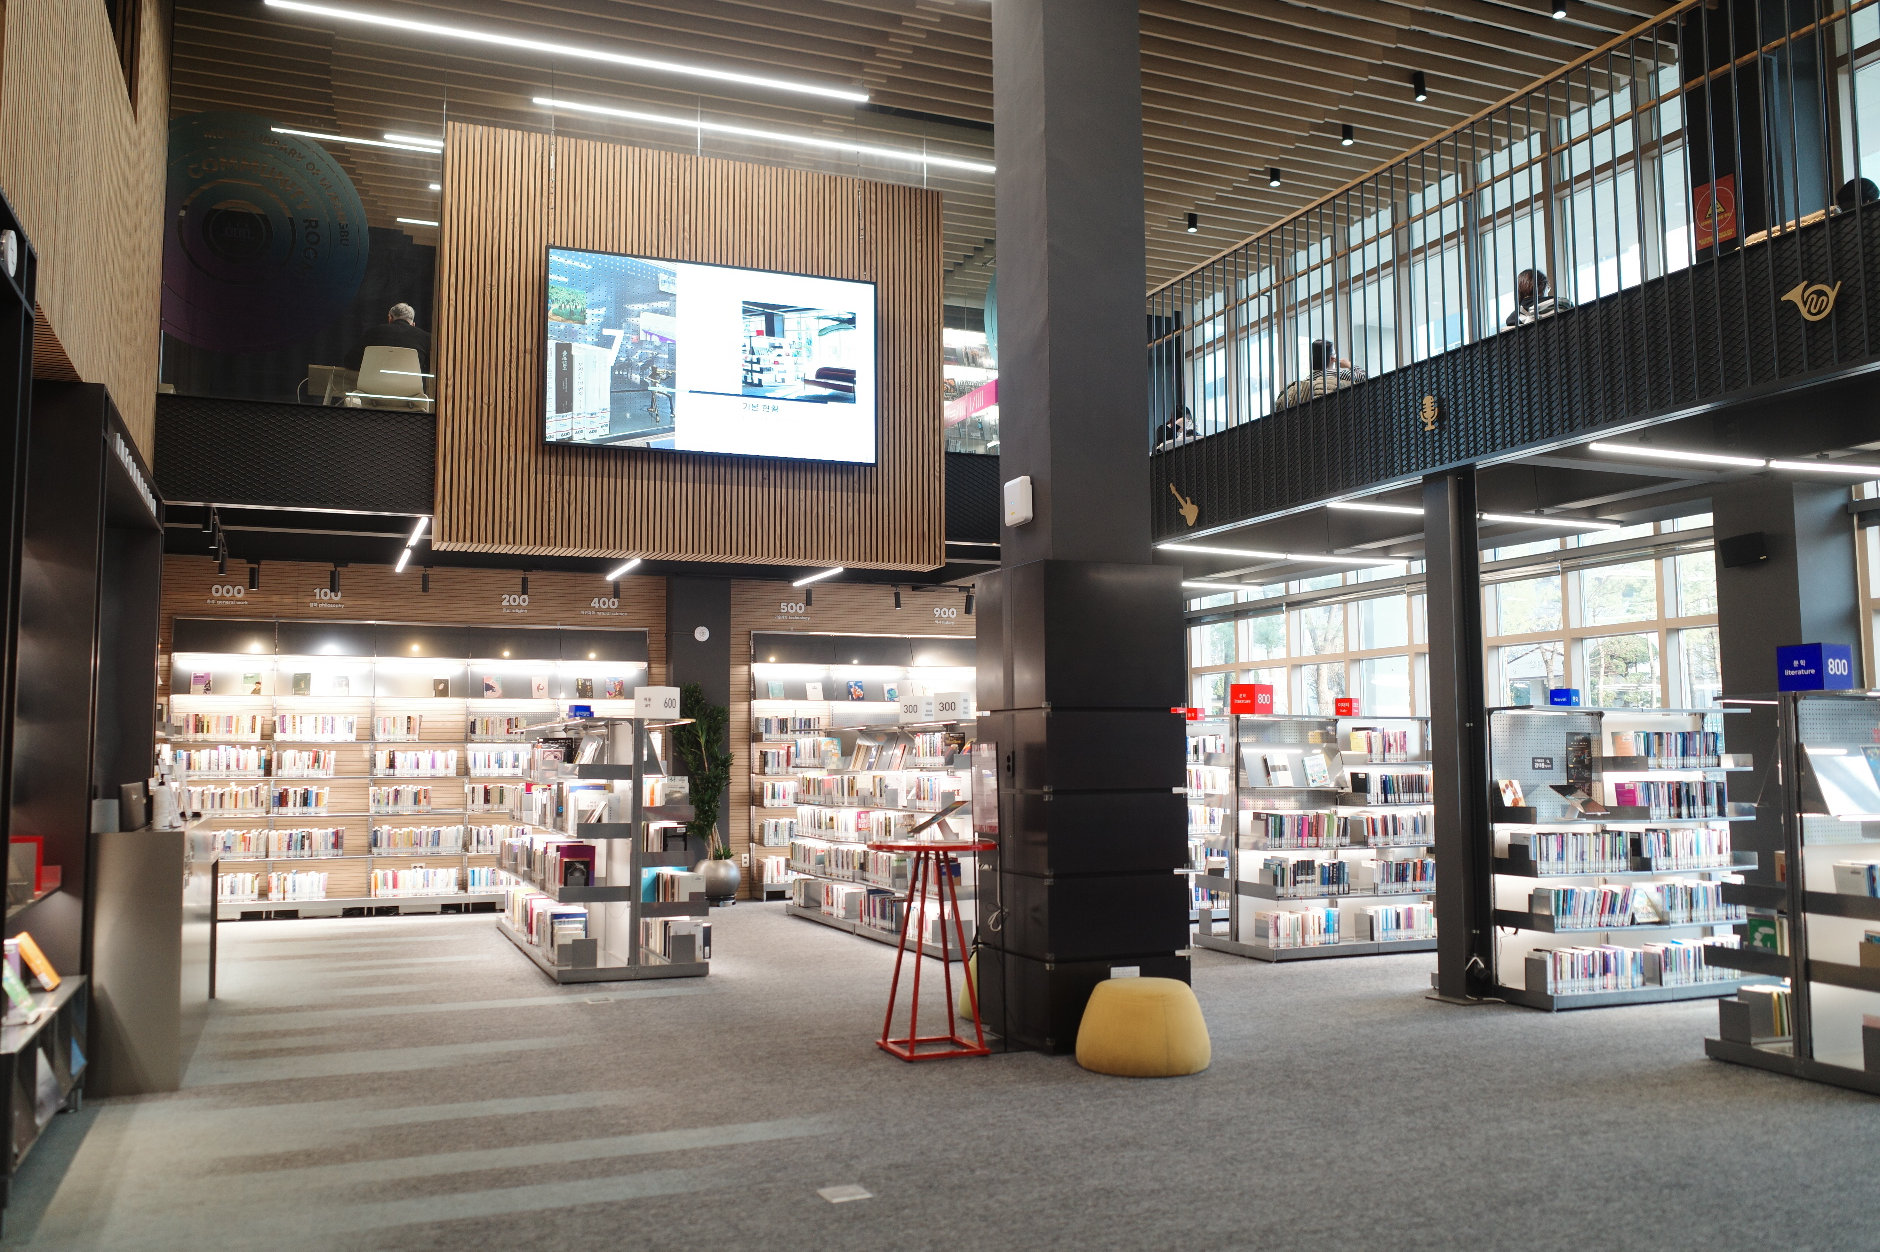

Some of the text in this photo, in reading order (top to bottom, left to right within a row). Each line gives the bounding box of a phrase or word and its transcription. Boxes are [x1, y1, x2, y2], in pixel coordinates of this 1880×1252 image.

[204, 129, 248, 140] MUSIC
[251, 132, 307, 162] LIBRARY
[305, 162, 321, 176] OF
[187, 156, 313, 210] COMMUNITY
[211, 584, 245, 598] 000
[313, 588, 342, 601] 100
[501, 594, 529, 606] 200
[590, 597, 619, 609] 400
[780, 602, 805, 614] 500
[933, 607, 957, 618] 900
[1784, 668, 1816, 676] literature
[1827, 658, 1849, 676] 800
[663, 697, 677, 709] 600
[1257, 693, 1271, 705] 800
[903, 704, 918, 714] 300
[938, 701, 956, 712] 300
